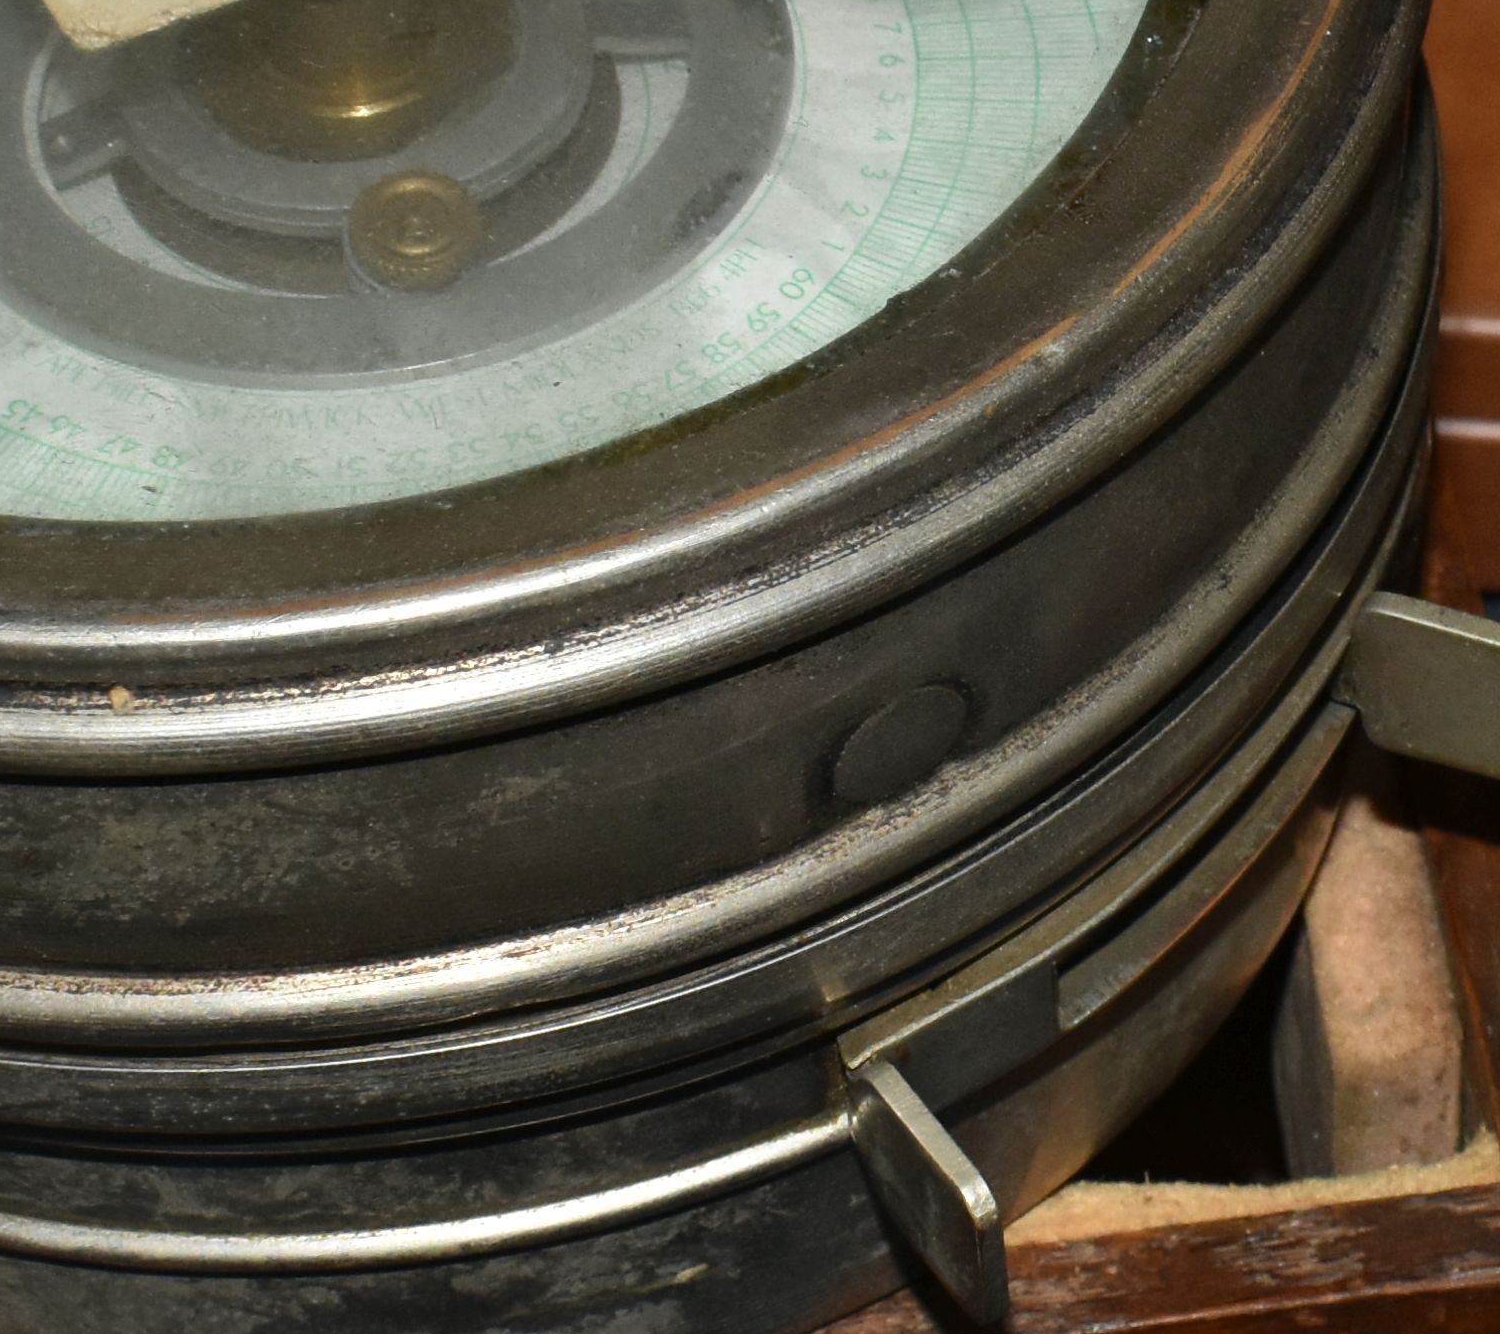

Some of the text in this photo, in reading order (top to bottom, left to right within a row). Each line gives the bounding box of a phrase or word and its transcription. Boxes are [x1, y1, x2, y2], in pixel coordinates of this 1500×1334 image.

[778, 266, 814, 300] 60
[746, 301, 781, 332] 59
[699, 331, 741, 363] 58
[664, 358, 697, 392] 57
[1, 398, 43, 422] 45
[50, 413, 87, 438] 46
[500, 423, 544, 451] 54
[97, 433, 141, 454] 47
[447, 436, 485, 463] 53
[209, 454, 250, 476] 49
[334, 455, 367, 478] 51
[387, 447, 427, 475] 52
